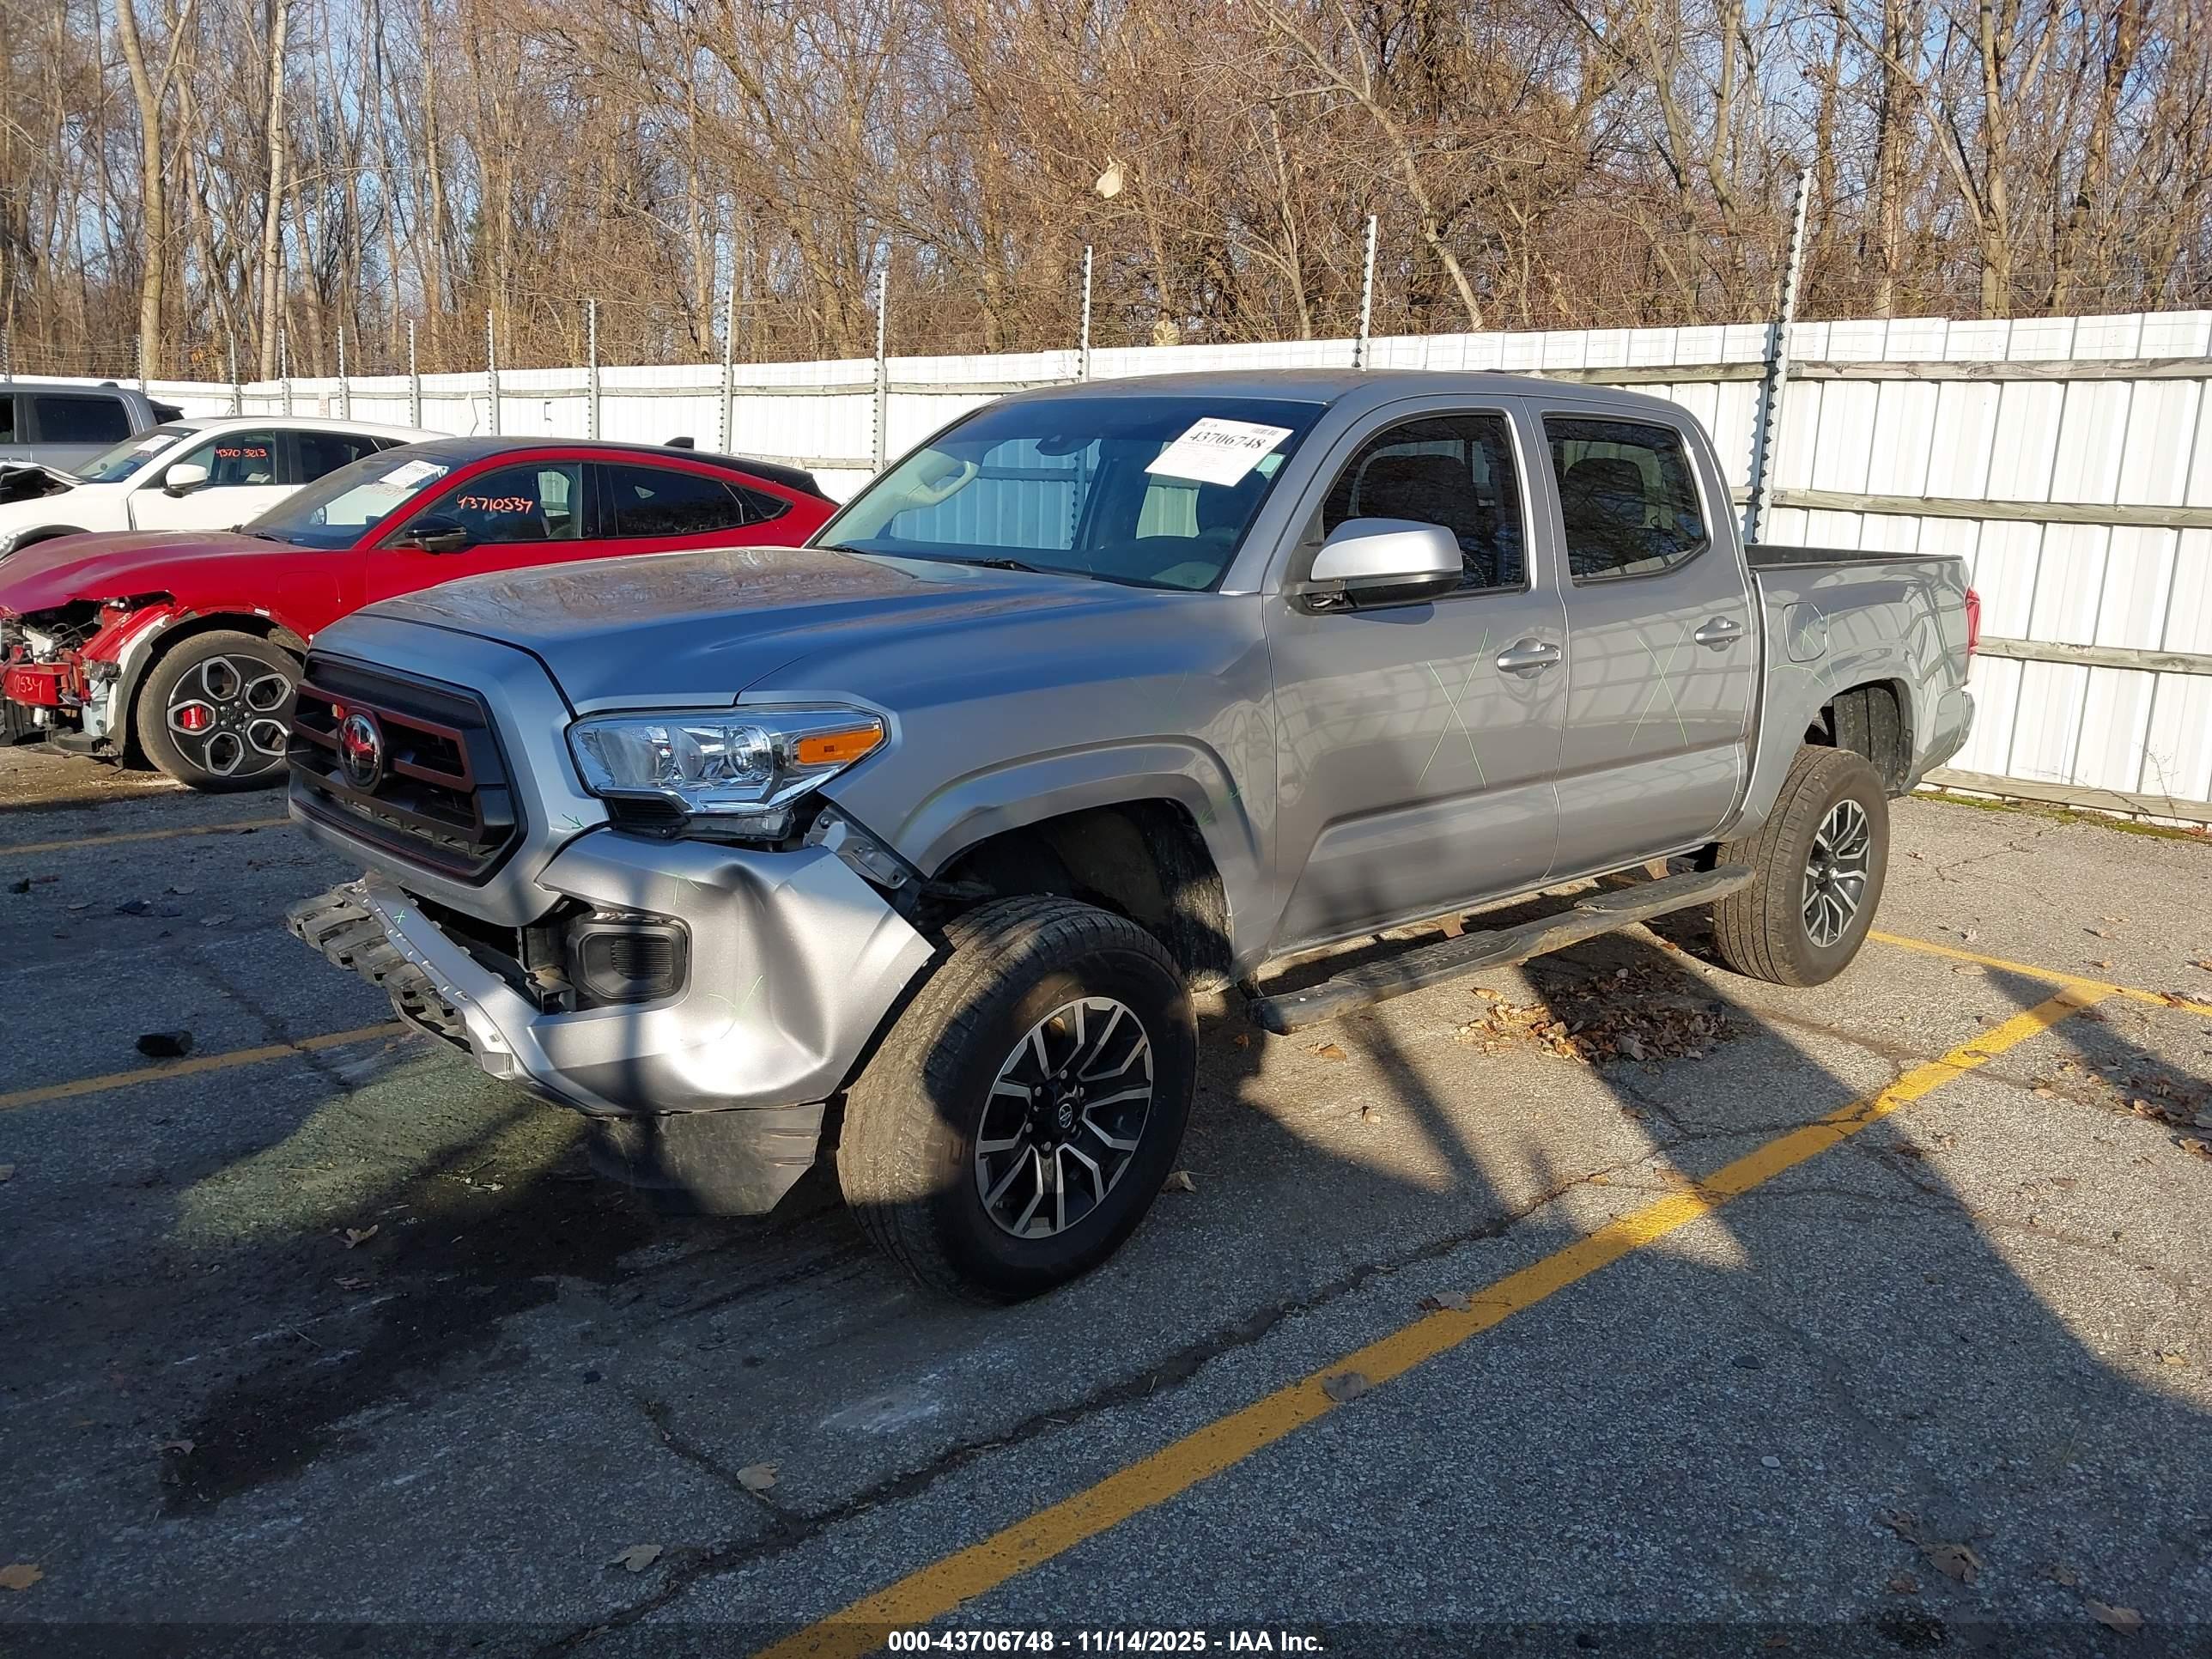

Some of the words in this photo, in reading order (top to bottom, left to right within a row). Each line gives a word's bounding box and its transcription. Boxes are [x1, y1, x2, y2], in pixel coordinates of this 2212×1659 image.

[1189, 431, 1267, 449] 43706748
[456, 494, 533, 514] 43710534
[14, 673, 43, 699] 0534
